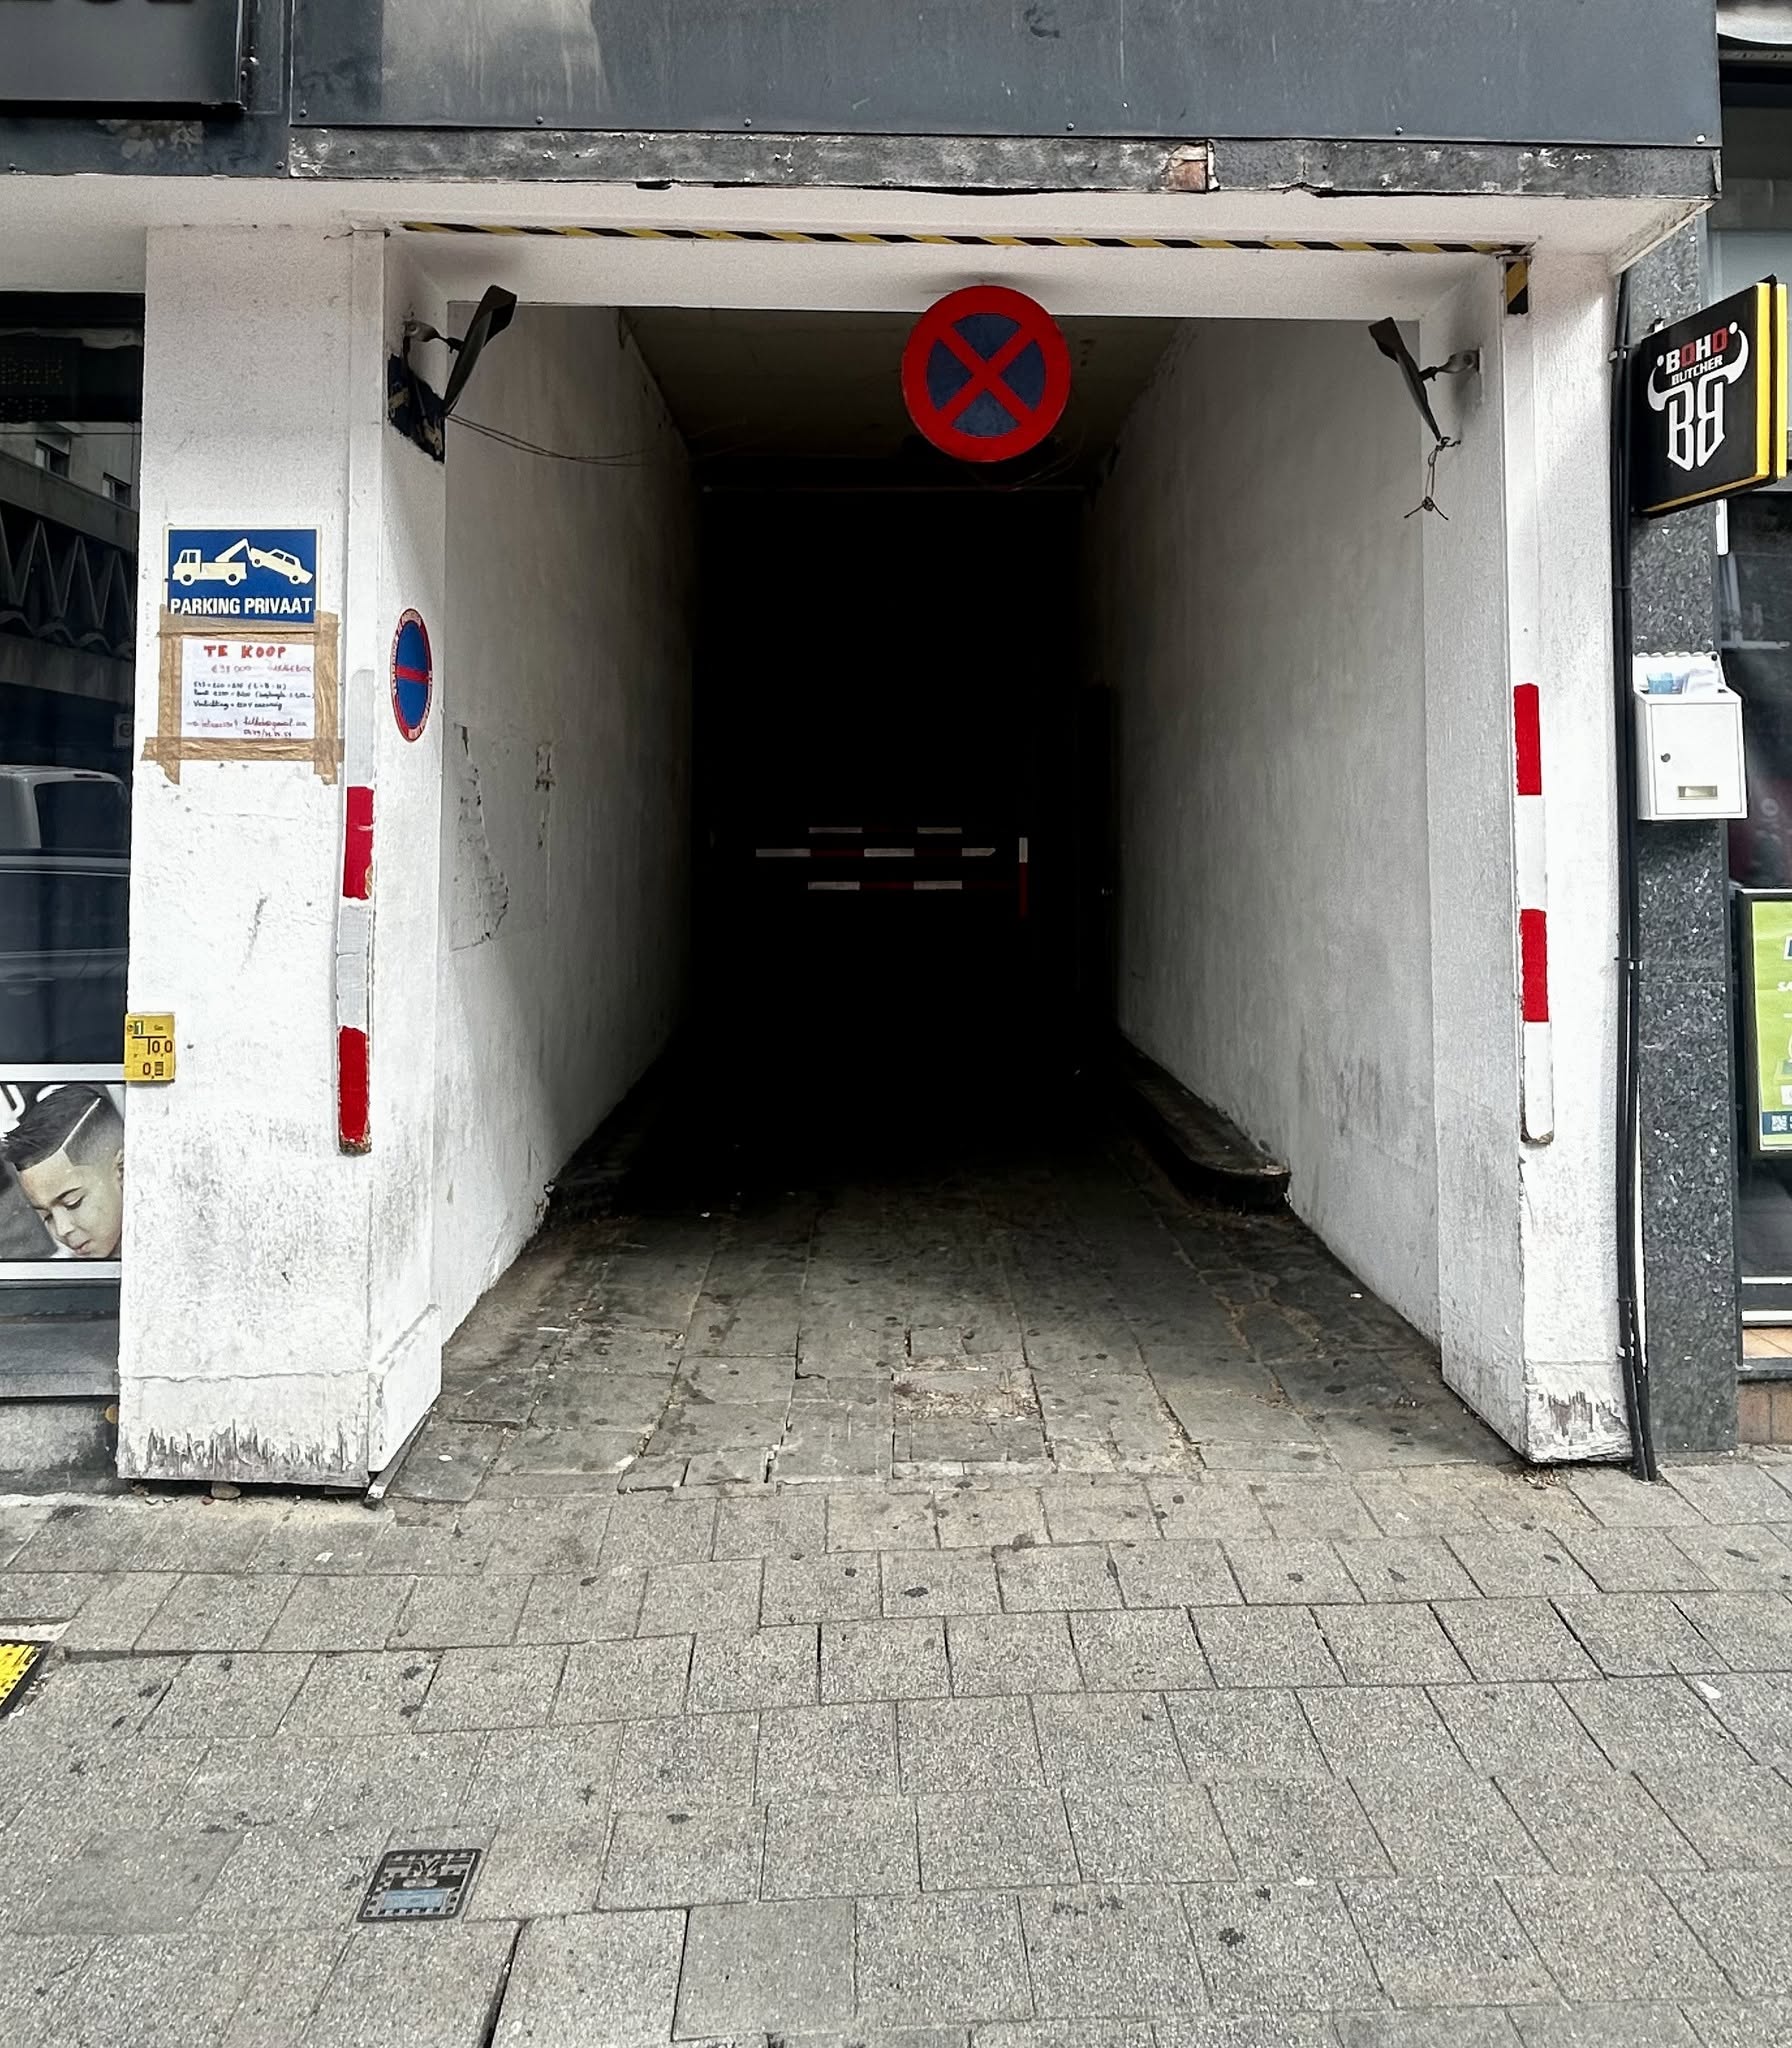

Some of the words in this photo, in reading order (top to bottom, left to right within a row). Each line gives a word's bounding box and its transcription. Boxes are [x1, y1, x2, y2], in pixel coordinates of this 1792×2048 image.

[1665, 327, 1729, 375] BOHO
[1671, 354, 1724, 386] BUTCHER
[170, 598, 241, 615] PARKING
[244, 597, 313, 614] PRIVAAT
[203, 645, 228, 657] TE
[241, 645, 286, 658] KOOP
